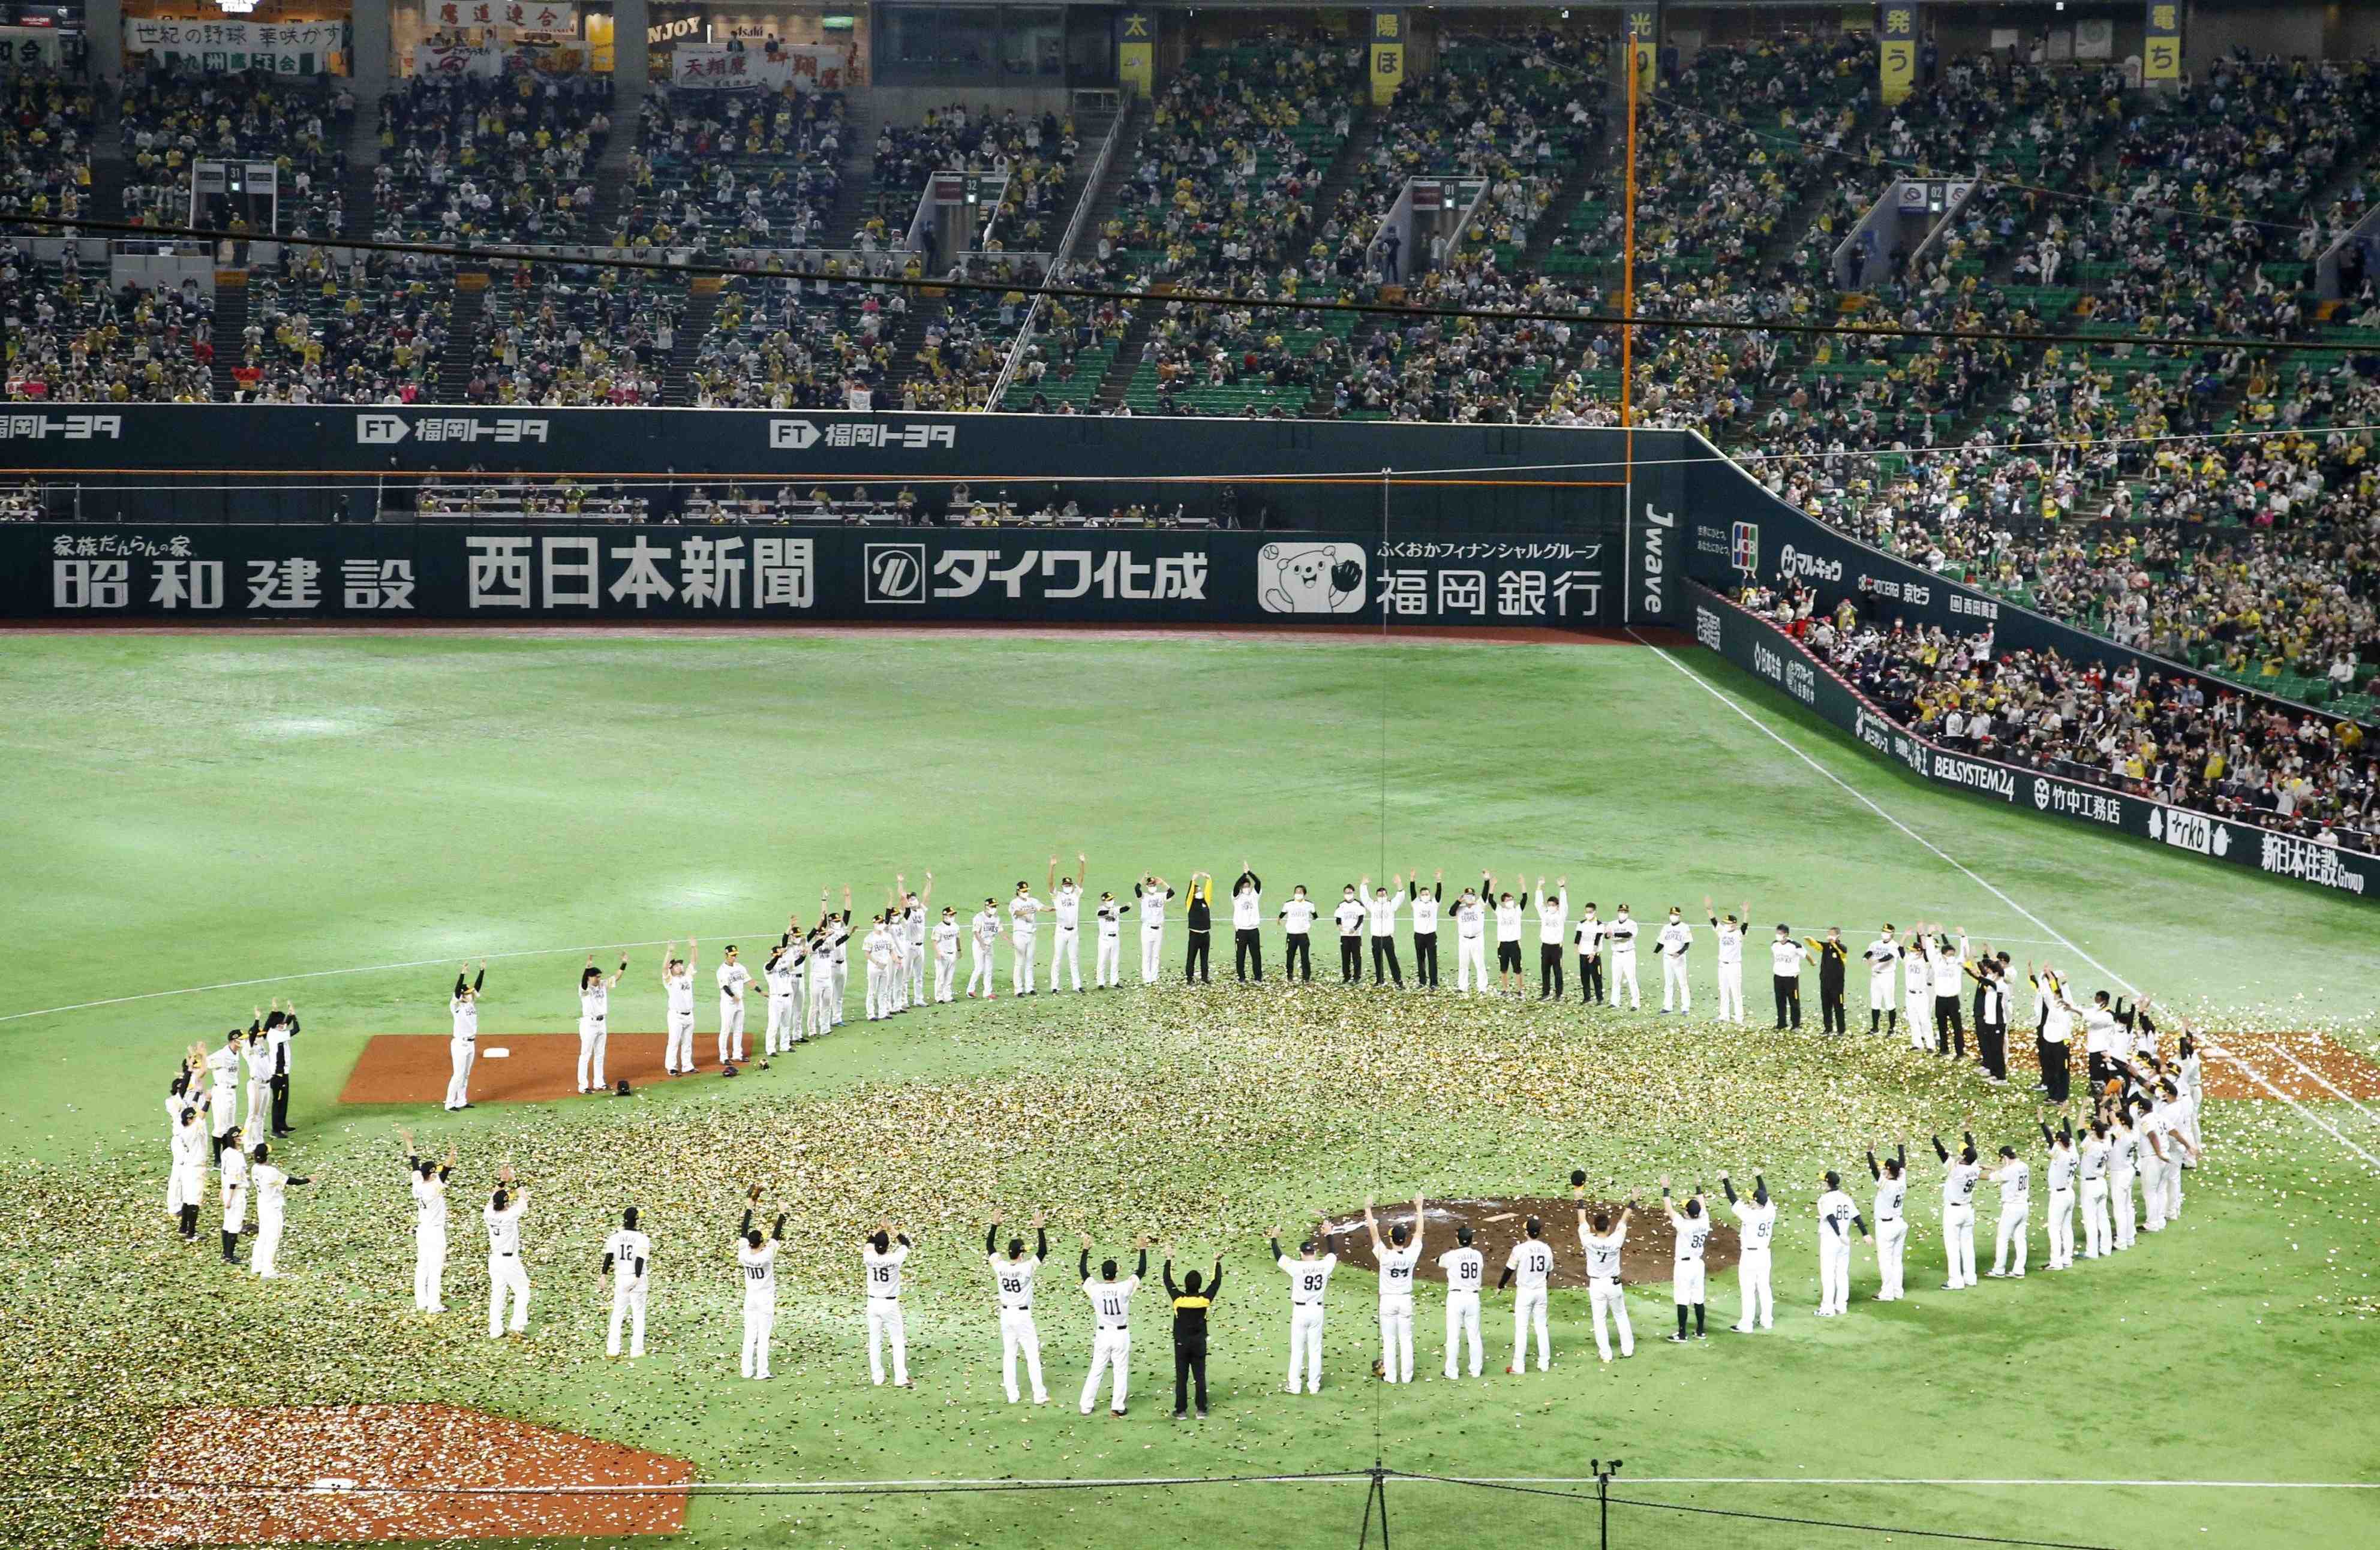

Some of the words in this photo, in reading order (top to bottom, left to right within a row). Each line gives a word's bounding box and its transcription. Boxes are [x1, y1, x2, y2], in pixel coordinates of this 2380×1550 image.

[136, 23, 247, 46] 世紀の野球
[1124, 13, 1147, 37] 太
[1630, 13, 1651, 36] 光
[1377, 52, 1397, 73] ほ
[1888, 49, 1907, 71] う
[2151, 45, 2172, 70] ち
[230, 167, 240, 179] 31
[1444, 184, 1455, 195] 01
[415, 419, 549, 443] 福岡トヨタ
[825, 423, 955, 448] 福岡トヨタ
[52, 535, 193, 556] 家族だんらんの家
[1377, 542, 1602, 559] ふくおかフィナンシャルグループ
[466, 535, 814, 610] 西日本新聞
[933, 549, 1209, 600] ダイワ化成
[1796, 553, 1843, 582] マルキョウ
[52, 557, 416, 609] 昭和建設
[1376, 569, 1602, 616] 福岡銀行
[2052, 784, 2121, 825] 竹中工務店
[2261, 832, 2339, 888] 新日本住設
[2337, 863, 2365, 895] Group
[620, 1244, 633, 1261] 12
[1529, 1256, 1545, 1272] 13
[872, 1266, 889, 1282] 16
[1461, 1262, 1479, 1278] 98
[1303, 1274, 1323, 1291] 93
[1103, 1298, 1122, 1316] 111
